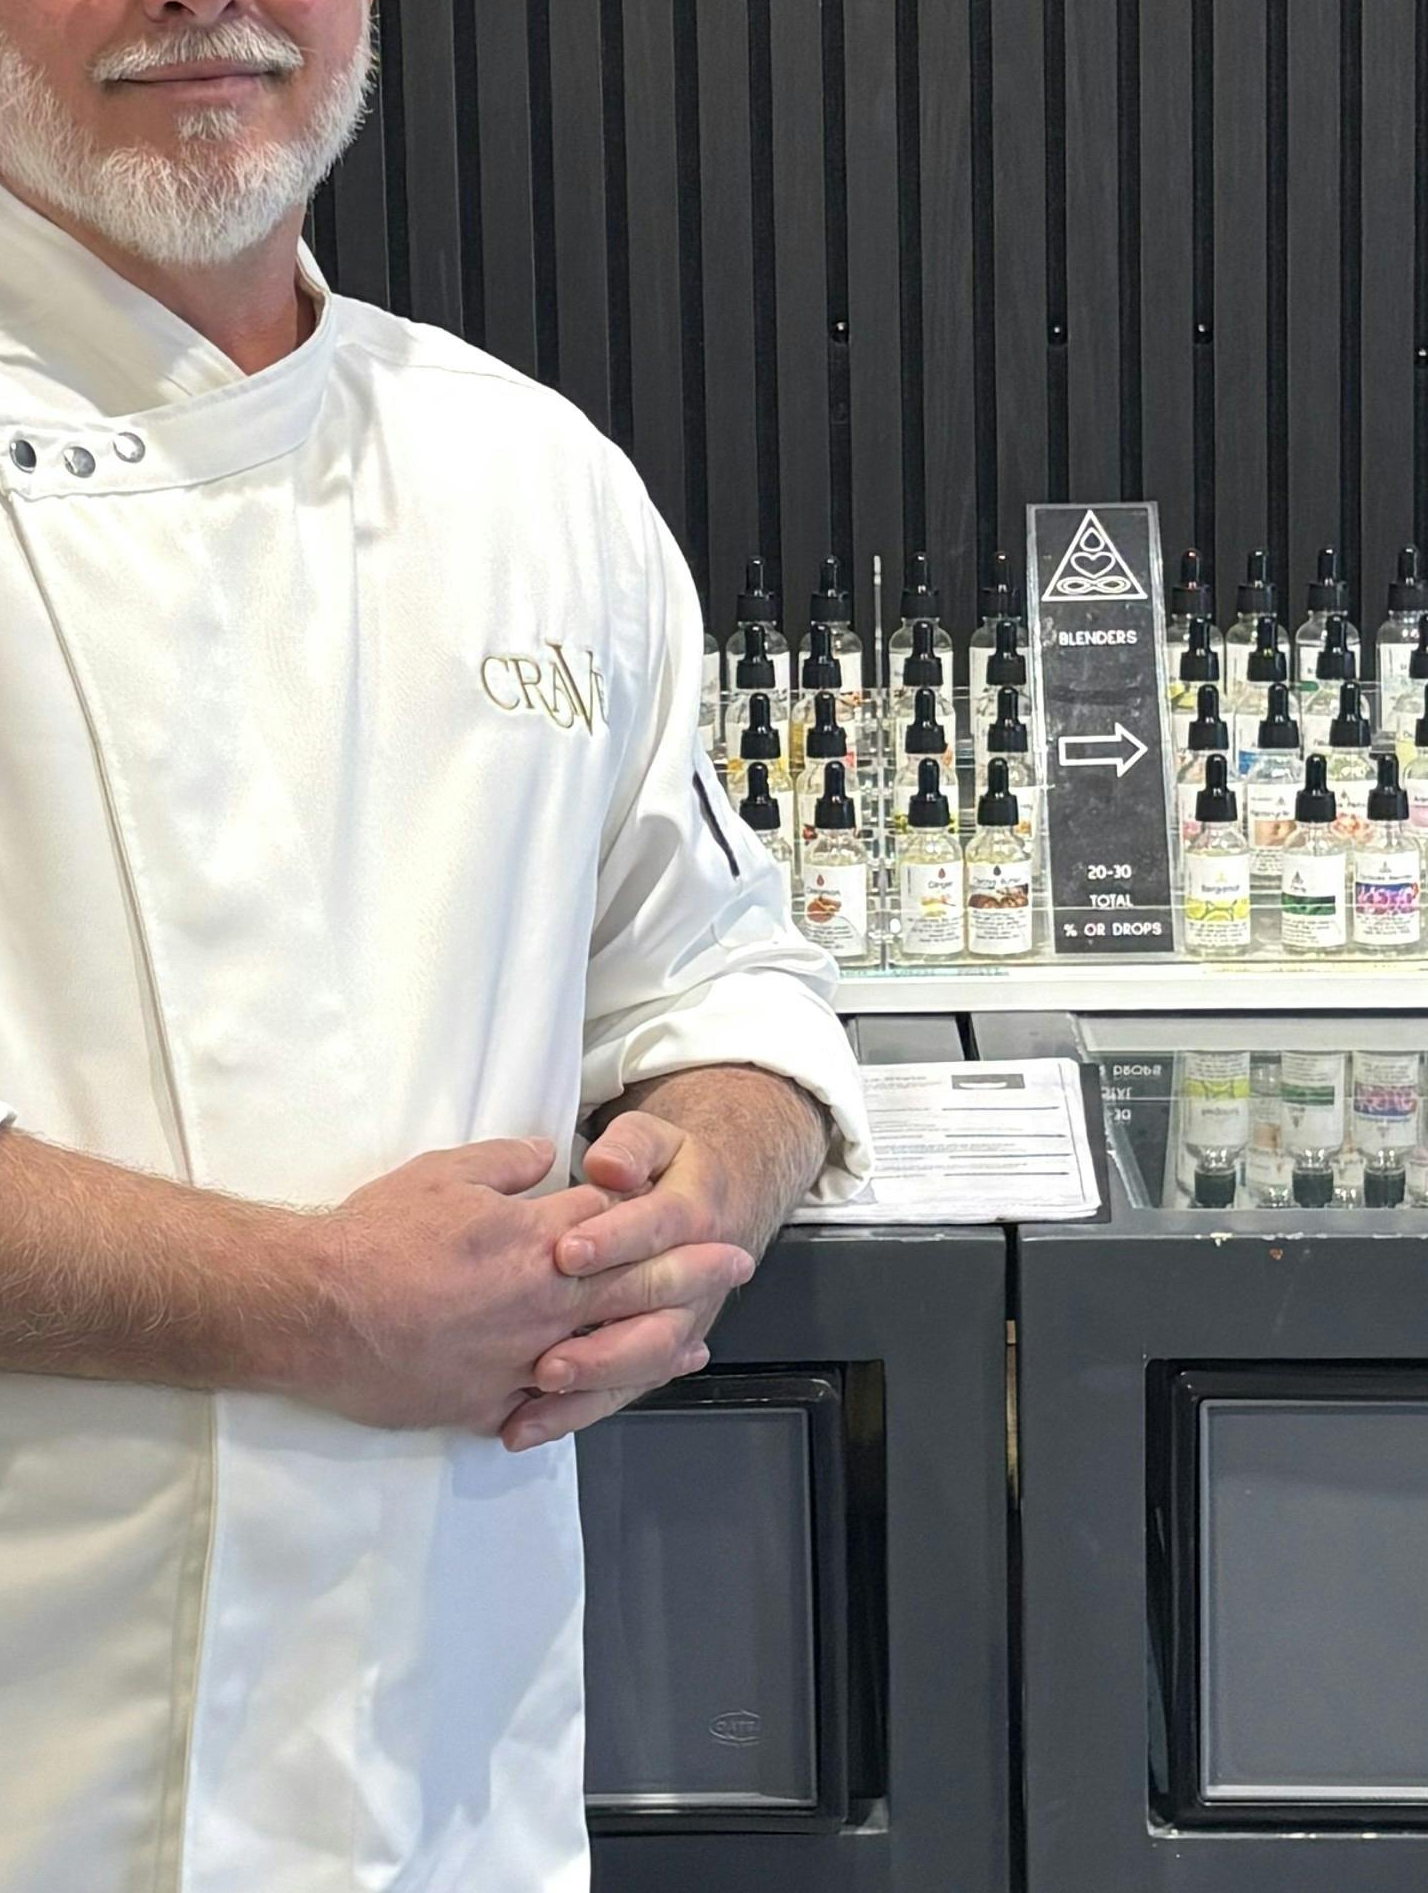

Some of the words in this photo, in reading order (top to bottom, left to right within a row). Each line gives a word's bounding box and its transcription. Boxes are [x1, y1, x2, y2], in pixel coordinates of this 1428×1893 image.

[1058, 629, 1138, 646] BLENDERS
[1087, 864, 1132, 880] 20-30
[1089, 894, 1134, 909] TOTAL
[1063, 923, 1078, 938] %
[1083, 922, 1106, 937] OR
[1112, 921, 1163, 937] DROPS
